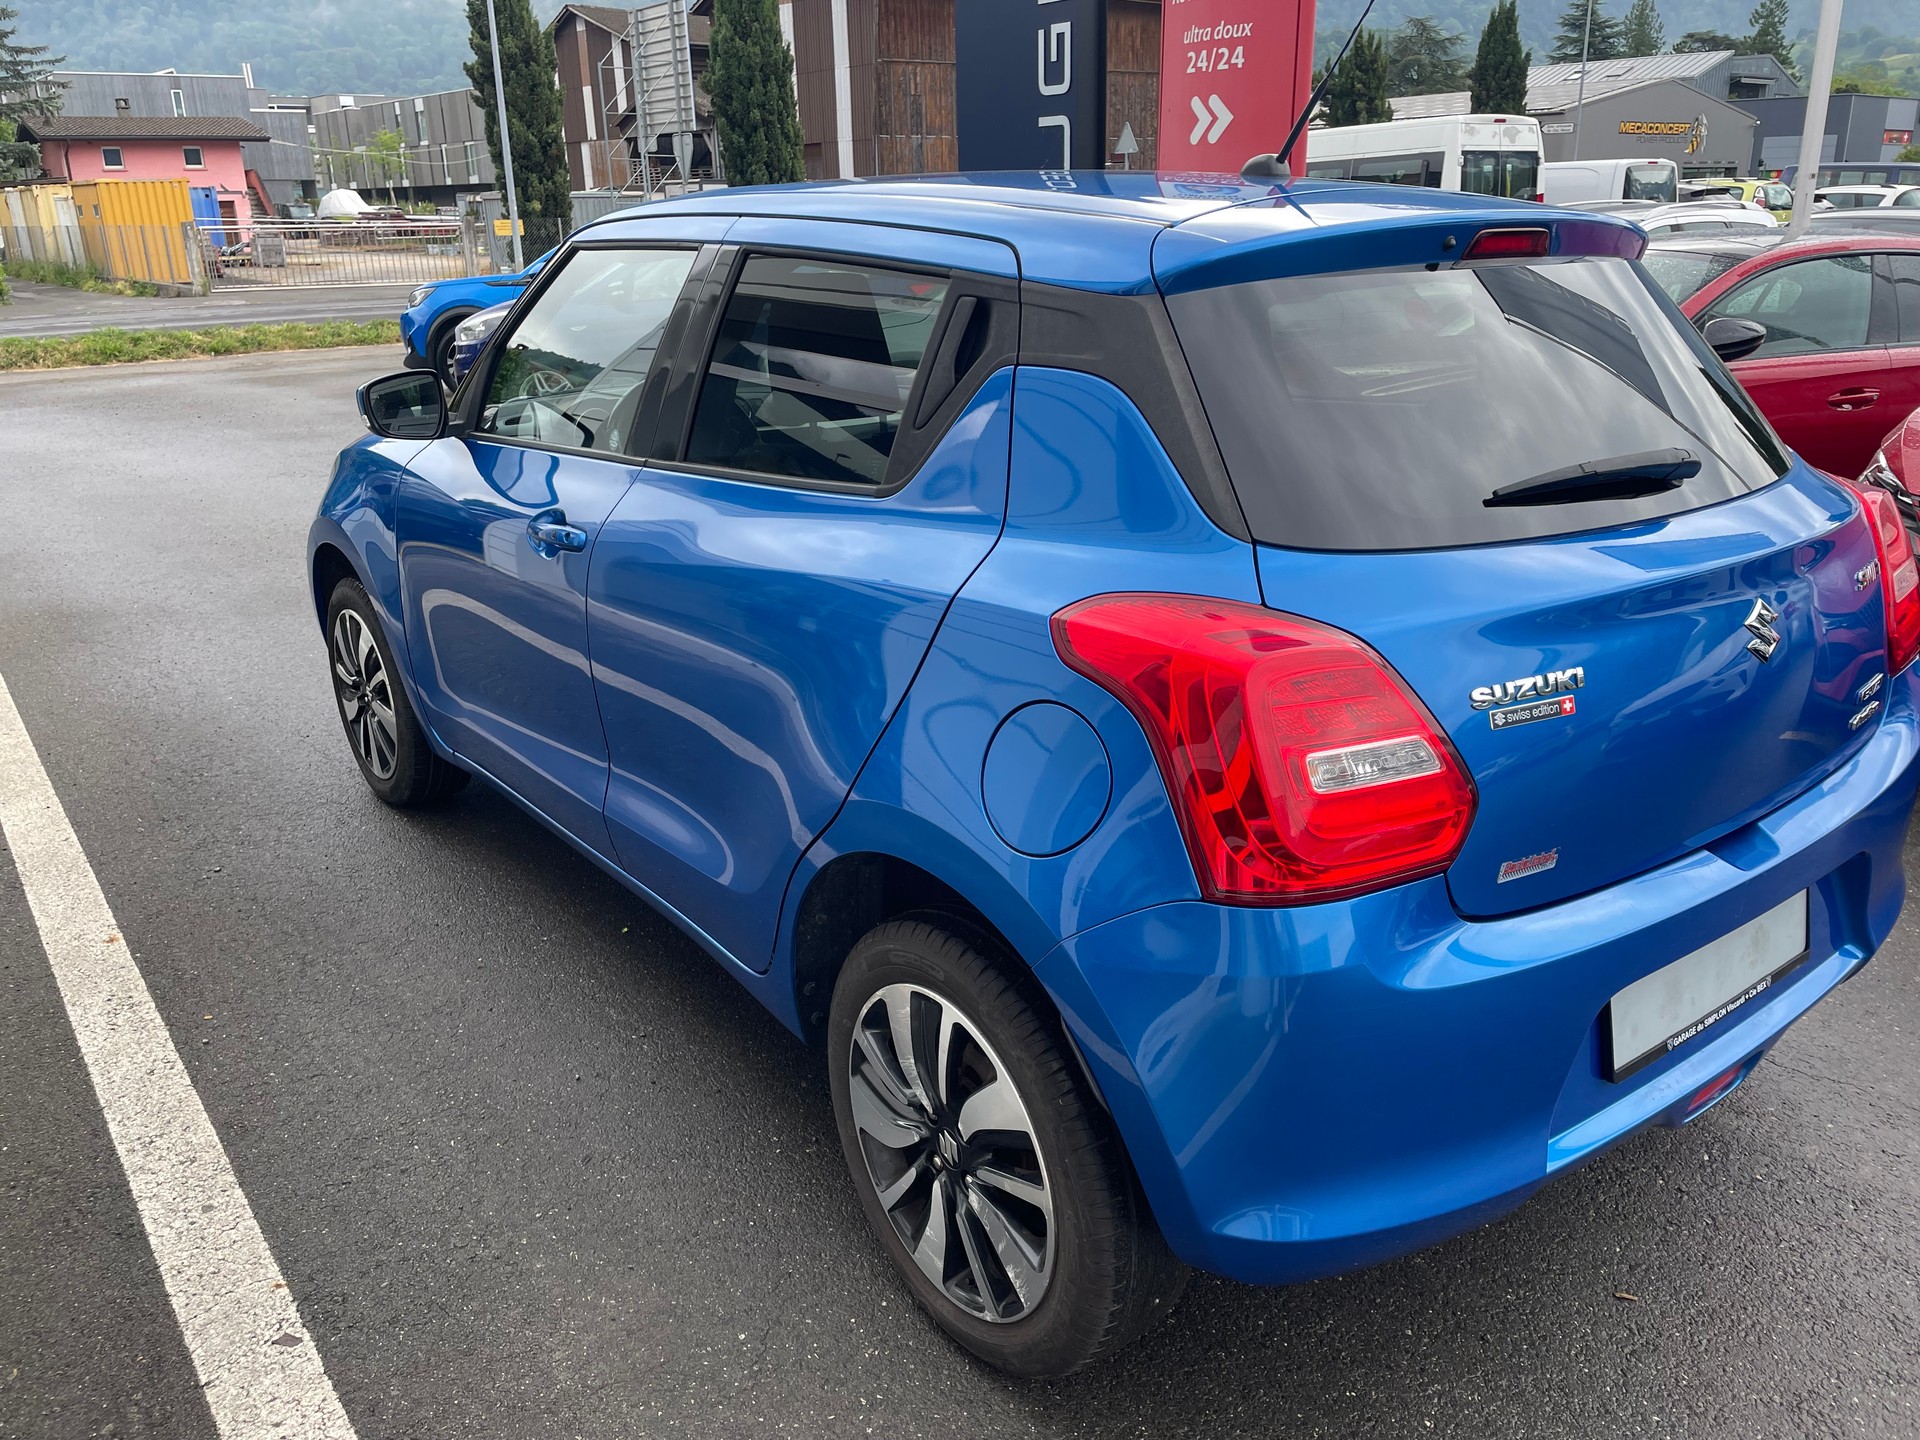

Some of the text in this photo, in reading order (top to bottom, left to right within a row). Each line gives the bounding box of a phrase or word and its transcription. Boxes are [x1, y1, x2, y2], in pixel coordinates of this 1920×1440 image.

[1183, 20, 1254, 44] ultra doux
[1186, 45, 1245, 74] 24/24
[1037, 0, 1072, 170] UG
[1618, 120, 1692, 135] MECACONCEPT
[1469, 666, 1585, 710] SUZUKI
[1506, 703, 1560, 723] swiss edition
[1673, 1025, 1697, 1046] GARAGE
[1696, 1022, 1705, 1032] du
[1704, 1007, 1727, 1027] SIMPLON
[1757, 980, 1767, 993] BEX
